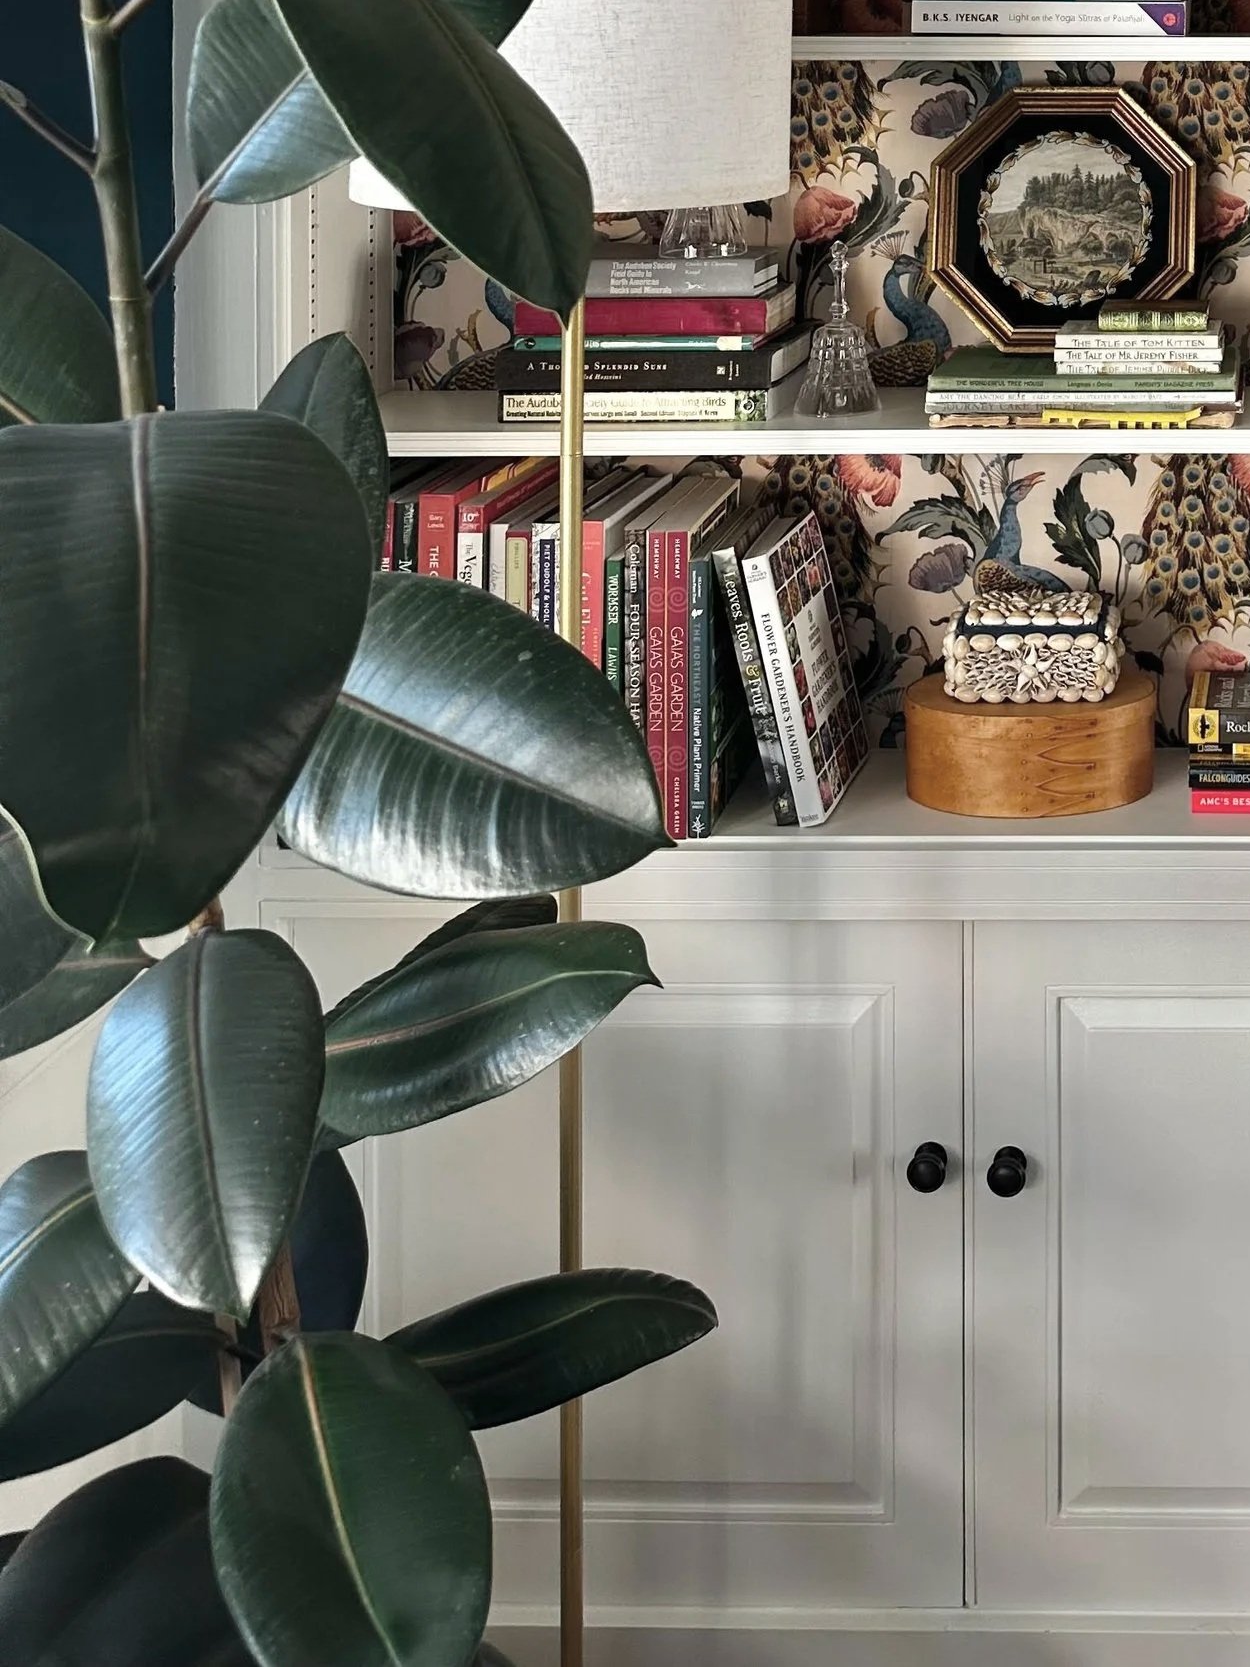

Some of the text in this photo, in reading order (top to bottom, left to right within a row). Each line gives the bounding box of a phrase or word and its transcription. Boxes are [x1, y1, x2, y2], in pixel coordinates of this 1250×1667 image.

[922, 13, 951, 22] B.K.S.
[955, 13, 999, 22] IYENGAR
[1008, 13, 1029, 24] Light
[1042, 14, 1053, 22] the
[1055, 13, 1076, 24] Yoga
[653, 262, 676, 271] Society
[1072, 338, 1206, 347] THE TALE OF TOM KITTEN
[528, 361, 668, 371] A SPLENDID SUNS
[1066, 351, 1199, 360] THE TALE OF JEREMY FISHER
[1066, 365, 1083, 374] THE
[506, 397, 726, 408] The Birds
[943, 403, 993, 411] JOURNEY
[430, 546, 439, 568] THE
[630, 544, 640, 593] Coleman
[543, 562, 551, 593] OUDOLF
[607, 574, 619, 681] WORMSER LAWNS
[649, 626, 663, 669] GAIA'S
[671, 626, 684, 669] GAIA'S
[735, 622, 754, 662] Roots
[693, 646, 702, 704] NORTHEAST
[746, 665, 760, 677] &
[649, 672, 663, 731] GARDEN
[671, 672, 684, 732] GARDEN
[748, 678, 767, 715] Fruit
[761, 613, 777, 656] FLOWER
[770, 658, 793, 723] GARDENER'S
[785, 725, 806, 782] HANDBOOK
[693, 707, 703, 736] Native
[693, 738, 703, 761] Plant
[693, 764, 703, 792] Primer
[1199, 773, 1250, 783] FALCONGUIDES
[1200, 798, 1229, 806] AMC'S
